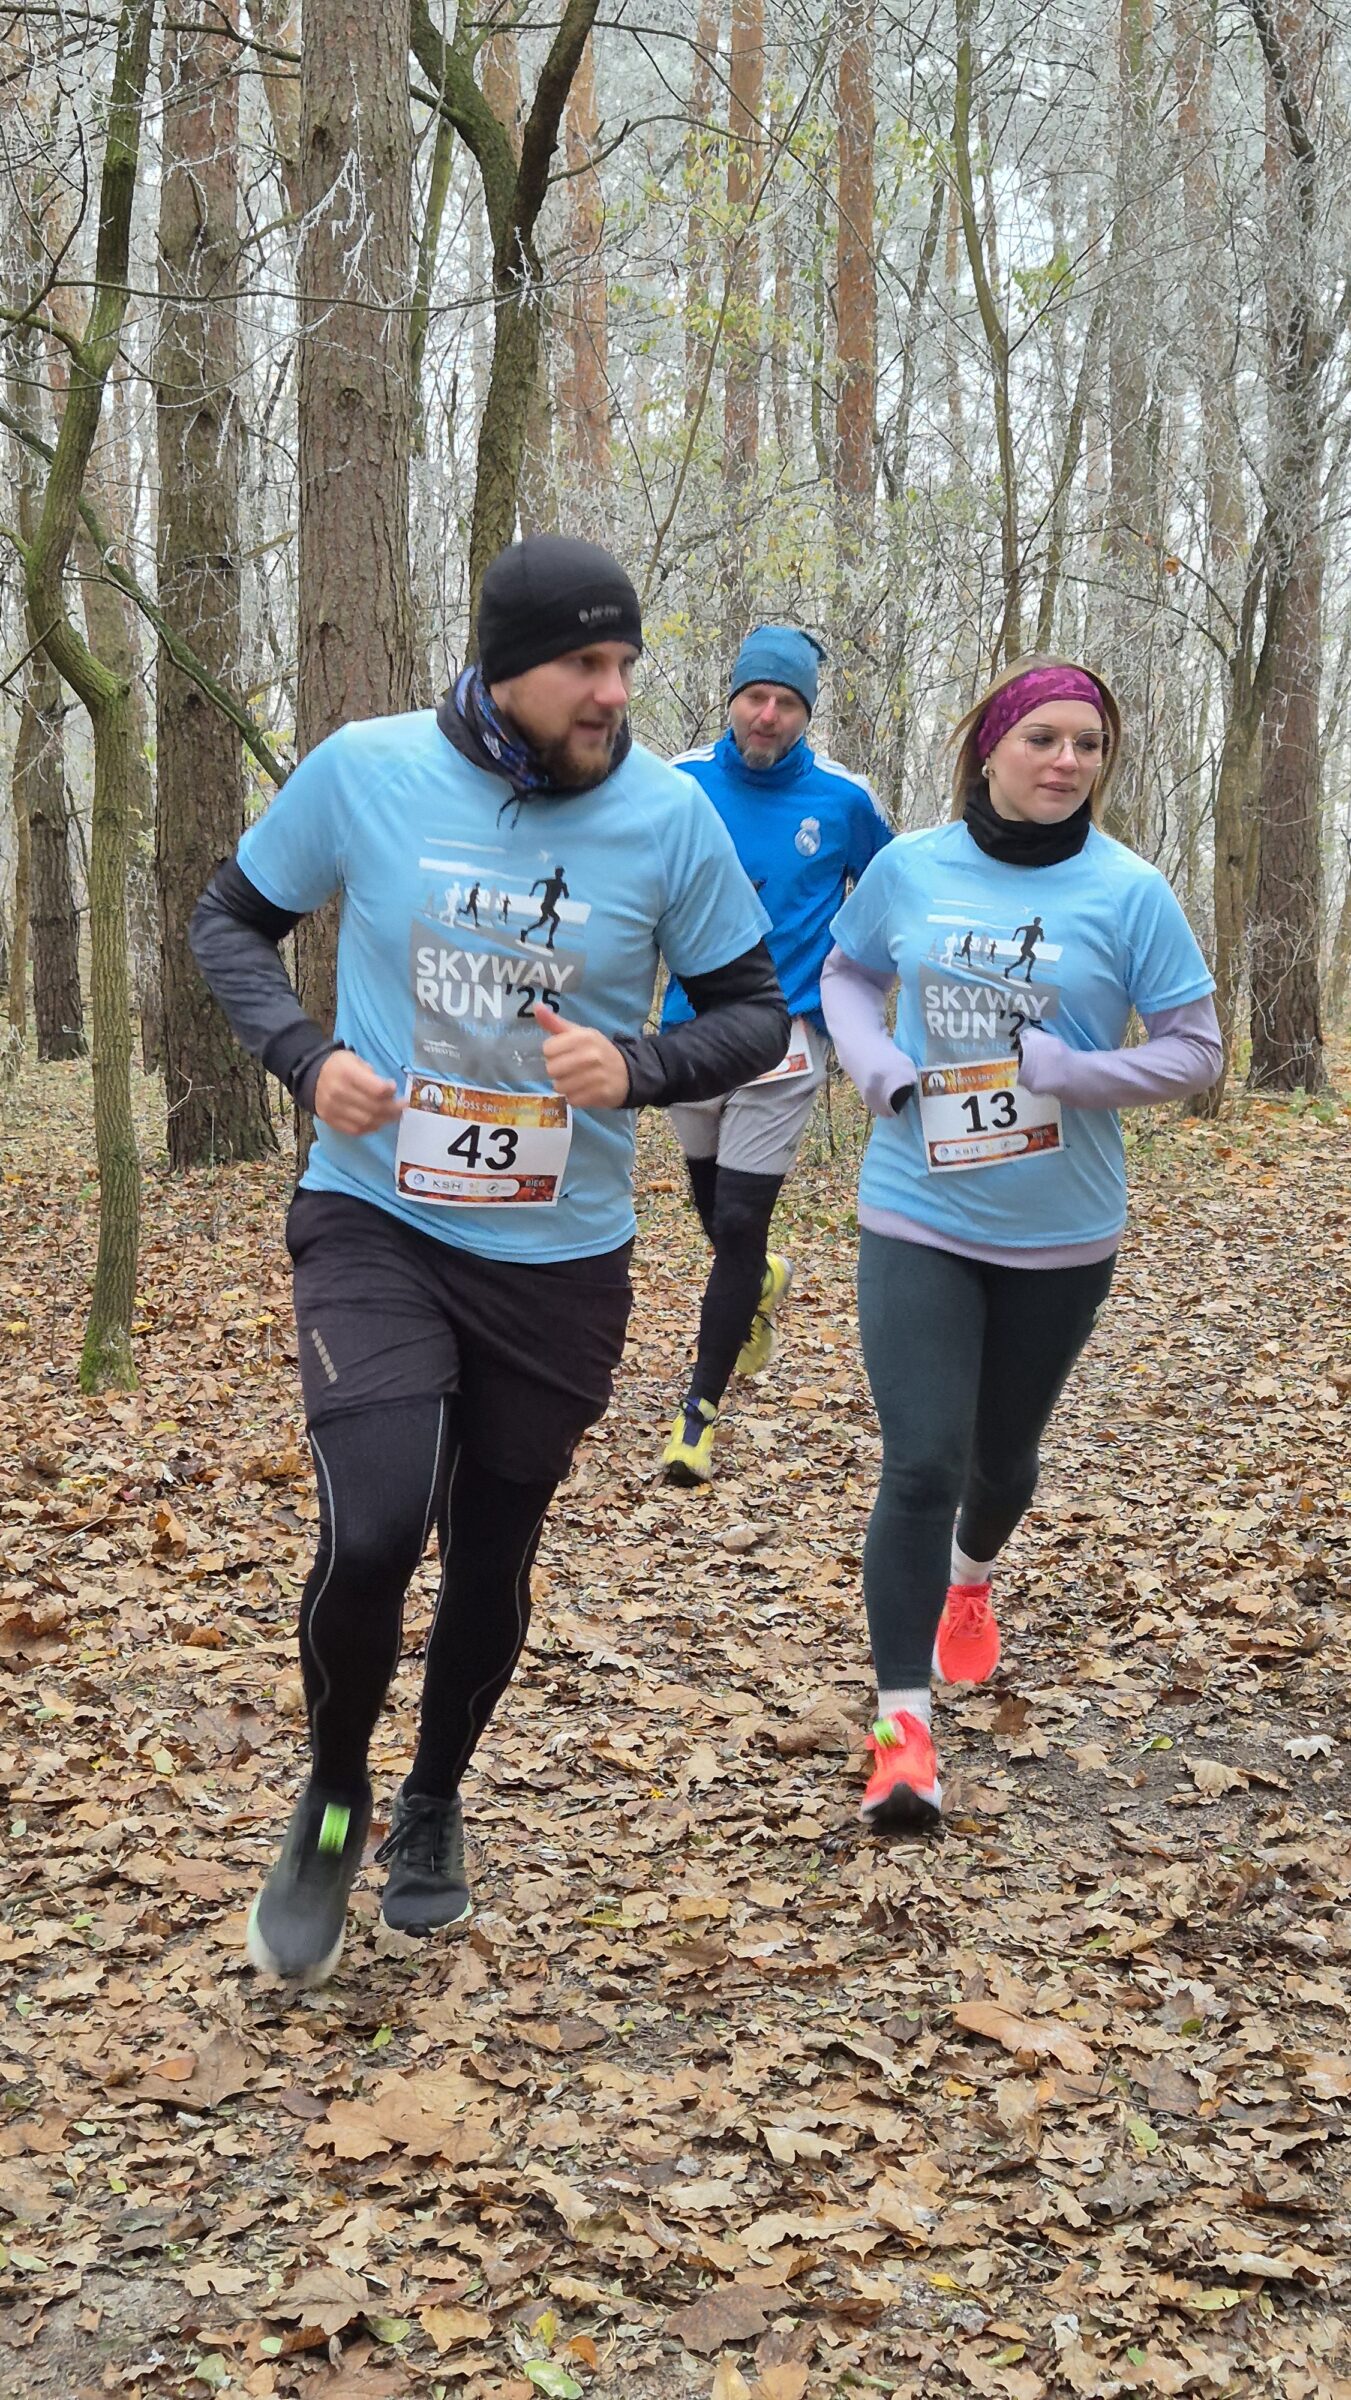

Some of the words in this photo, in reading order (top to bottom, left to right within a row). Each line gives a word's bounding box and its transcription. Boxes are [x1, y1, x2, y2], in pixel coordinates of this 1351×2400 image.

[416, 947, 574, 993] SKYWAY
[416, 977, 561, 1019] RUN'25
[925, 985, 1050, 1018] SKYWAY
[961, 1091, 1018, 1133] 13
[447, 1124, 519, 1170] 43
